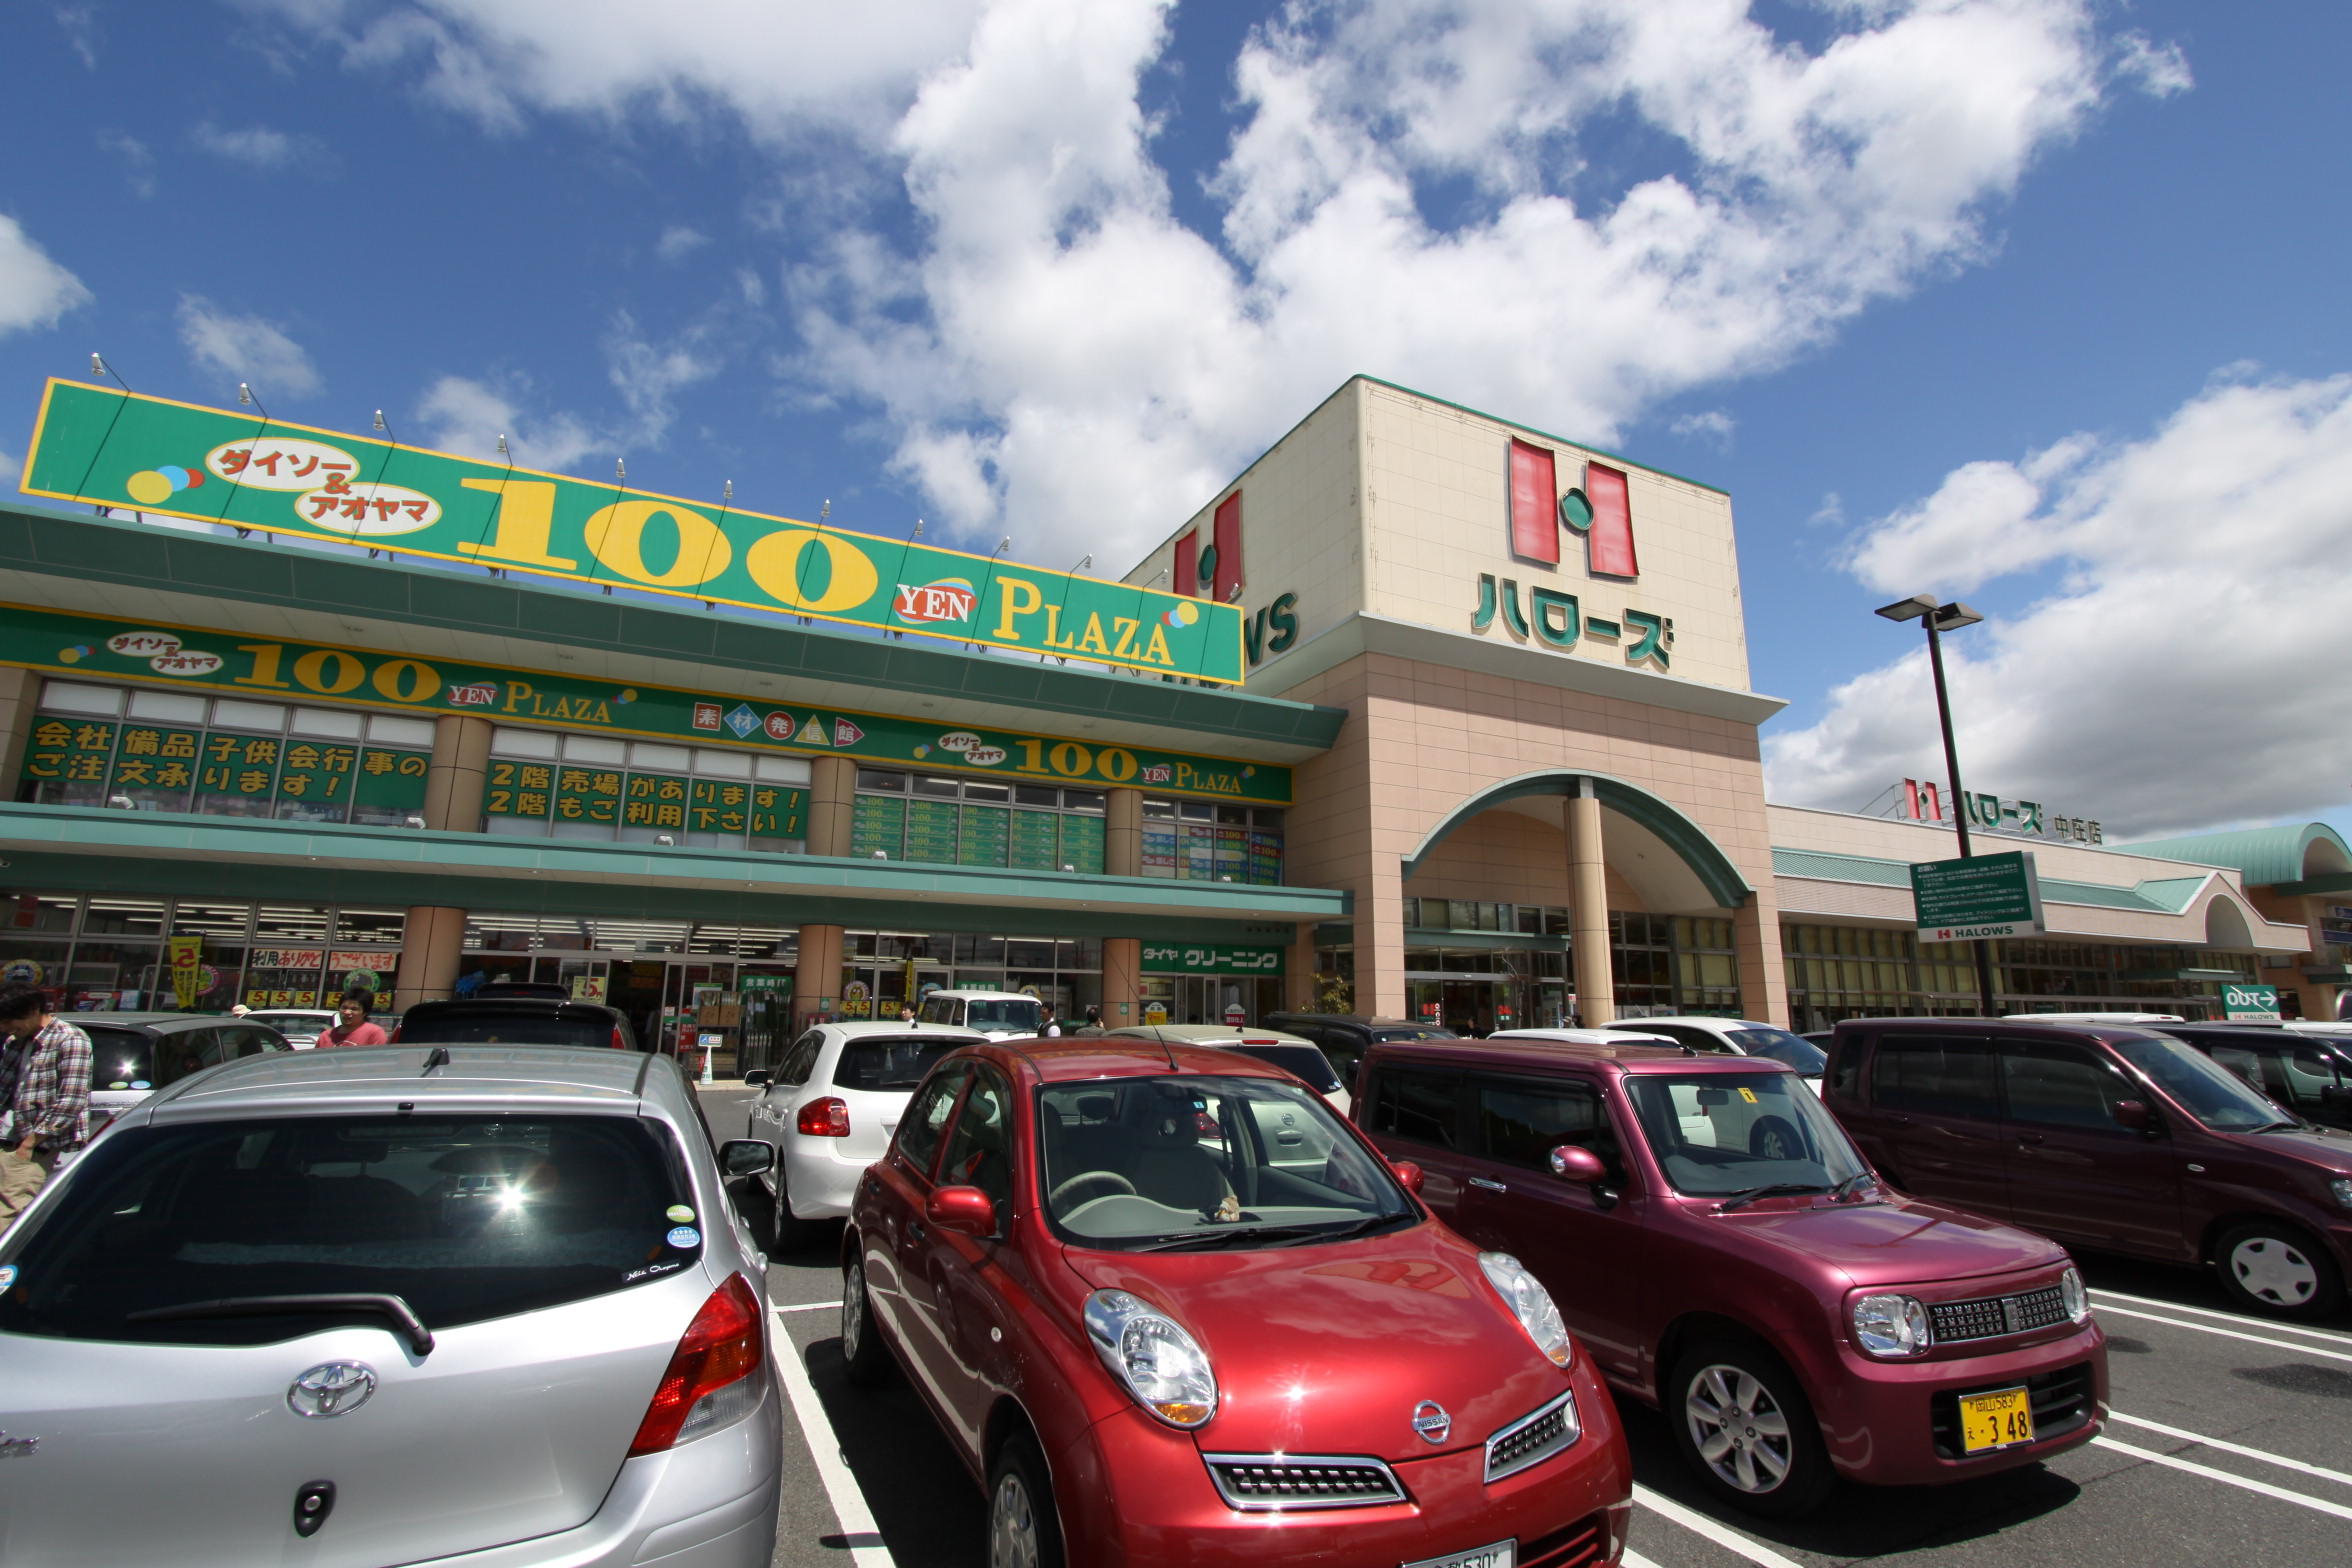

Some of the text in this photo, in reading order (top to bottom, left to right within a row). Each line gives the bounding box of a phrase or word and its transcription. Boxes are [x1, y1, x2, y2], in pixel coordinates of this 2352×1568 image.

[219, 449, 352, 478] ダイソー
[309, 496, 430, 523] アオヤマ
[457, 477, 879, 612] 100
[896, 583, 973, 624] YEN
[992, 575, 1176, 667] PLAZA
[1471, 572, 1676, 669] ハローズ
[113, 637, 180, 651] ダイソー
[157, 657, 218, 670] アオヤマ
[233, 643, 613, 723] 100 YEN PLAZA
[697, 707, 857, 744] 素材発信館
[1015, 739, 1243, 794] 100 YEN PLAZA
[1955, 925, 2014, 938] HALOWS
[1184, 949, 1278, 969] クリーニング
[2226, 992, 2260, 1006] OUT
[1417, 1415, 1450, 1429] NISSAN
